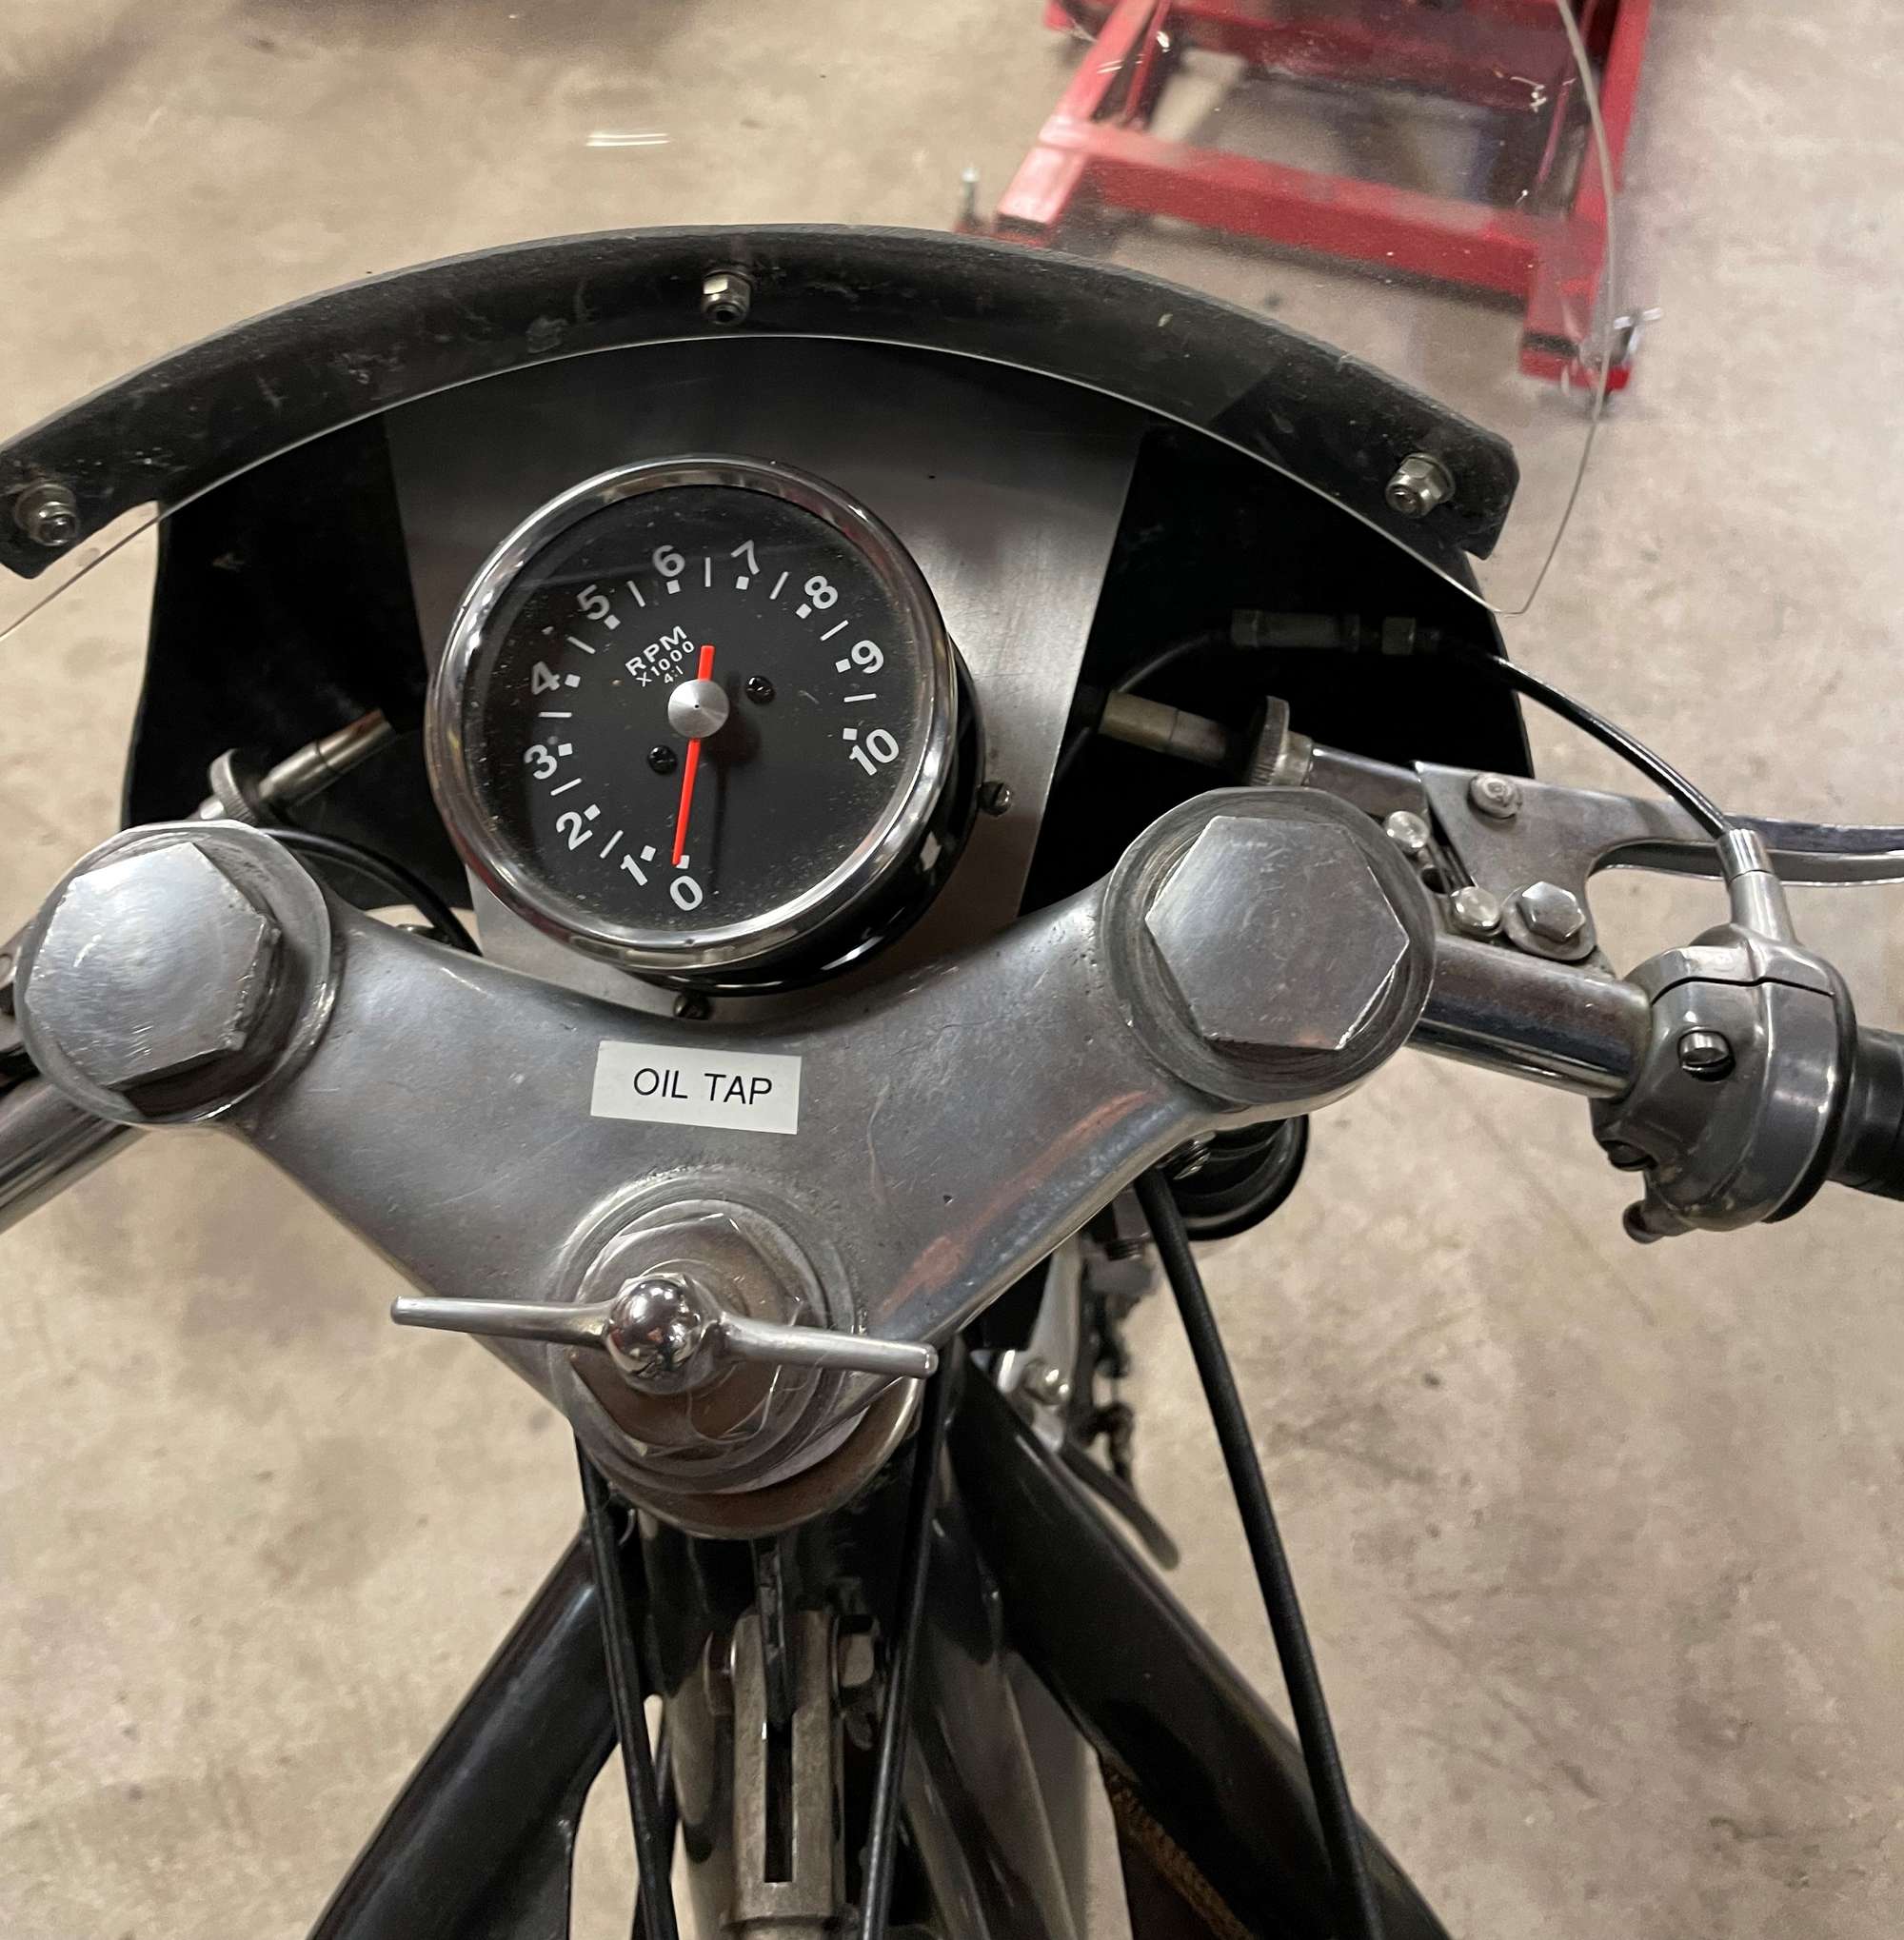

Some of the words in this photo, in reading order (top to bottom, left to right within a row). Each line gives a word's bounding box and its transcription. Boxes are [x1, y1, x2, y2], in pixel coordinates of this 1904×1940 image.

[652, 545, 684, 576] 6
[731, 540, 760, 575] 7
[577, 584, 610, 620] 5
[804, 576, 838, 609] 8
[625, 625, 687, 676] RPM
[851, 640, 883, 674] 9
[531, 661, 560, 696] 4
[524, 744, 556, 780] 3
[849, 729, 899, 775] 10
[556, 812, 592, 850] 2
[621, 854, 647, 885] 1
[669, 875, 704, 911] 0
[633, 1067, 688, 1099] OIL
[704, 1073, 772, 1104] TAP
